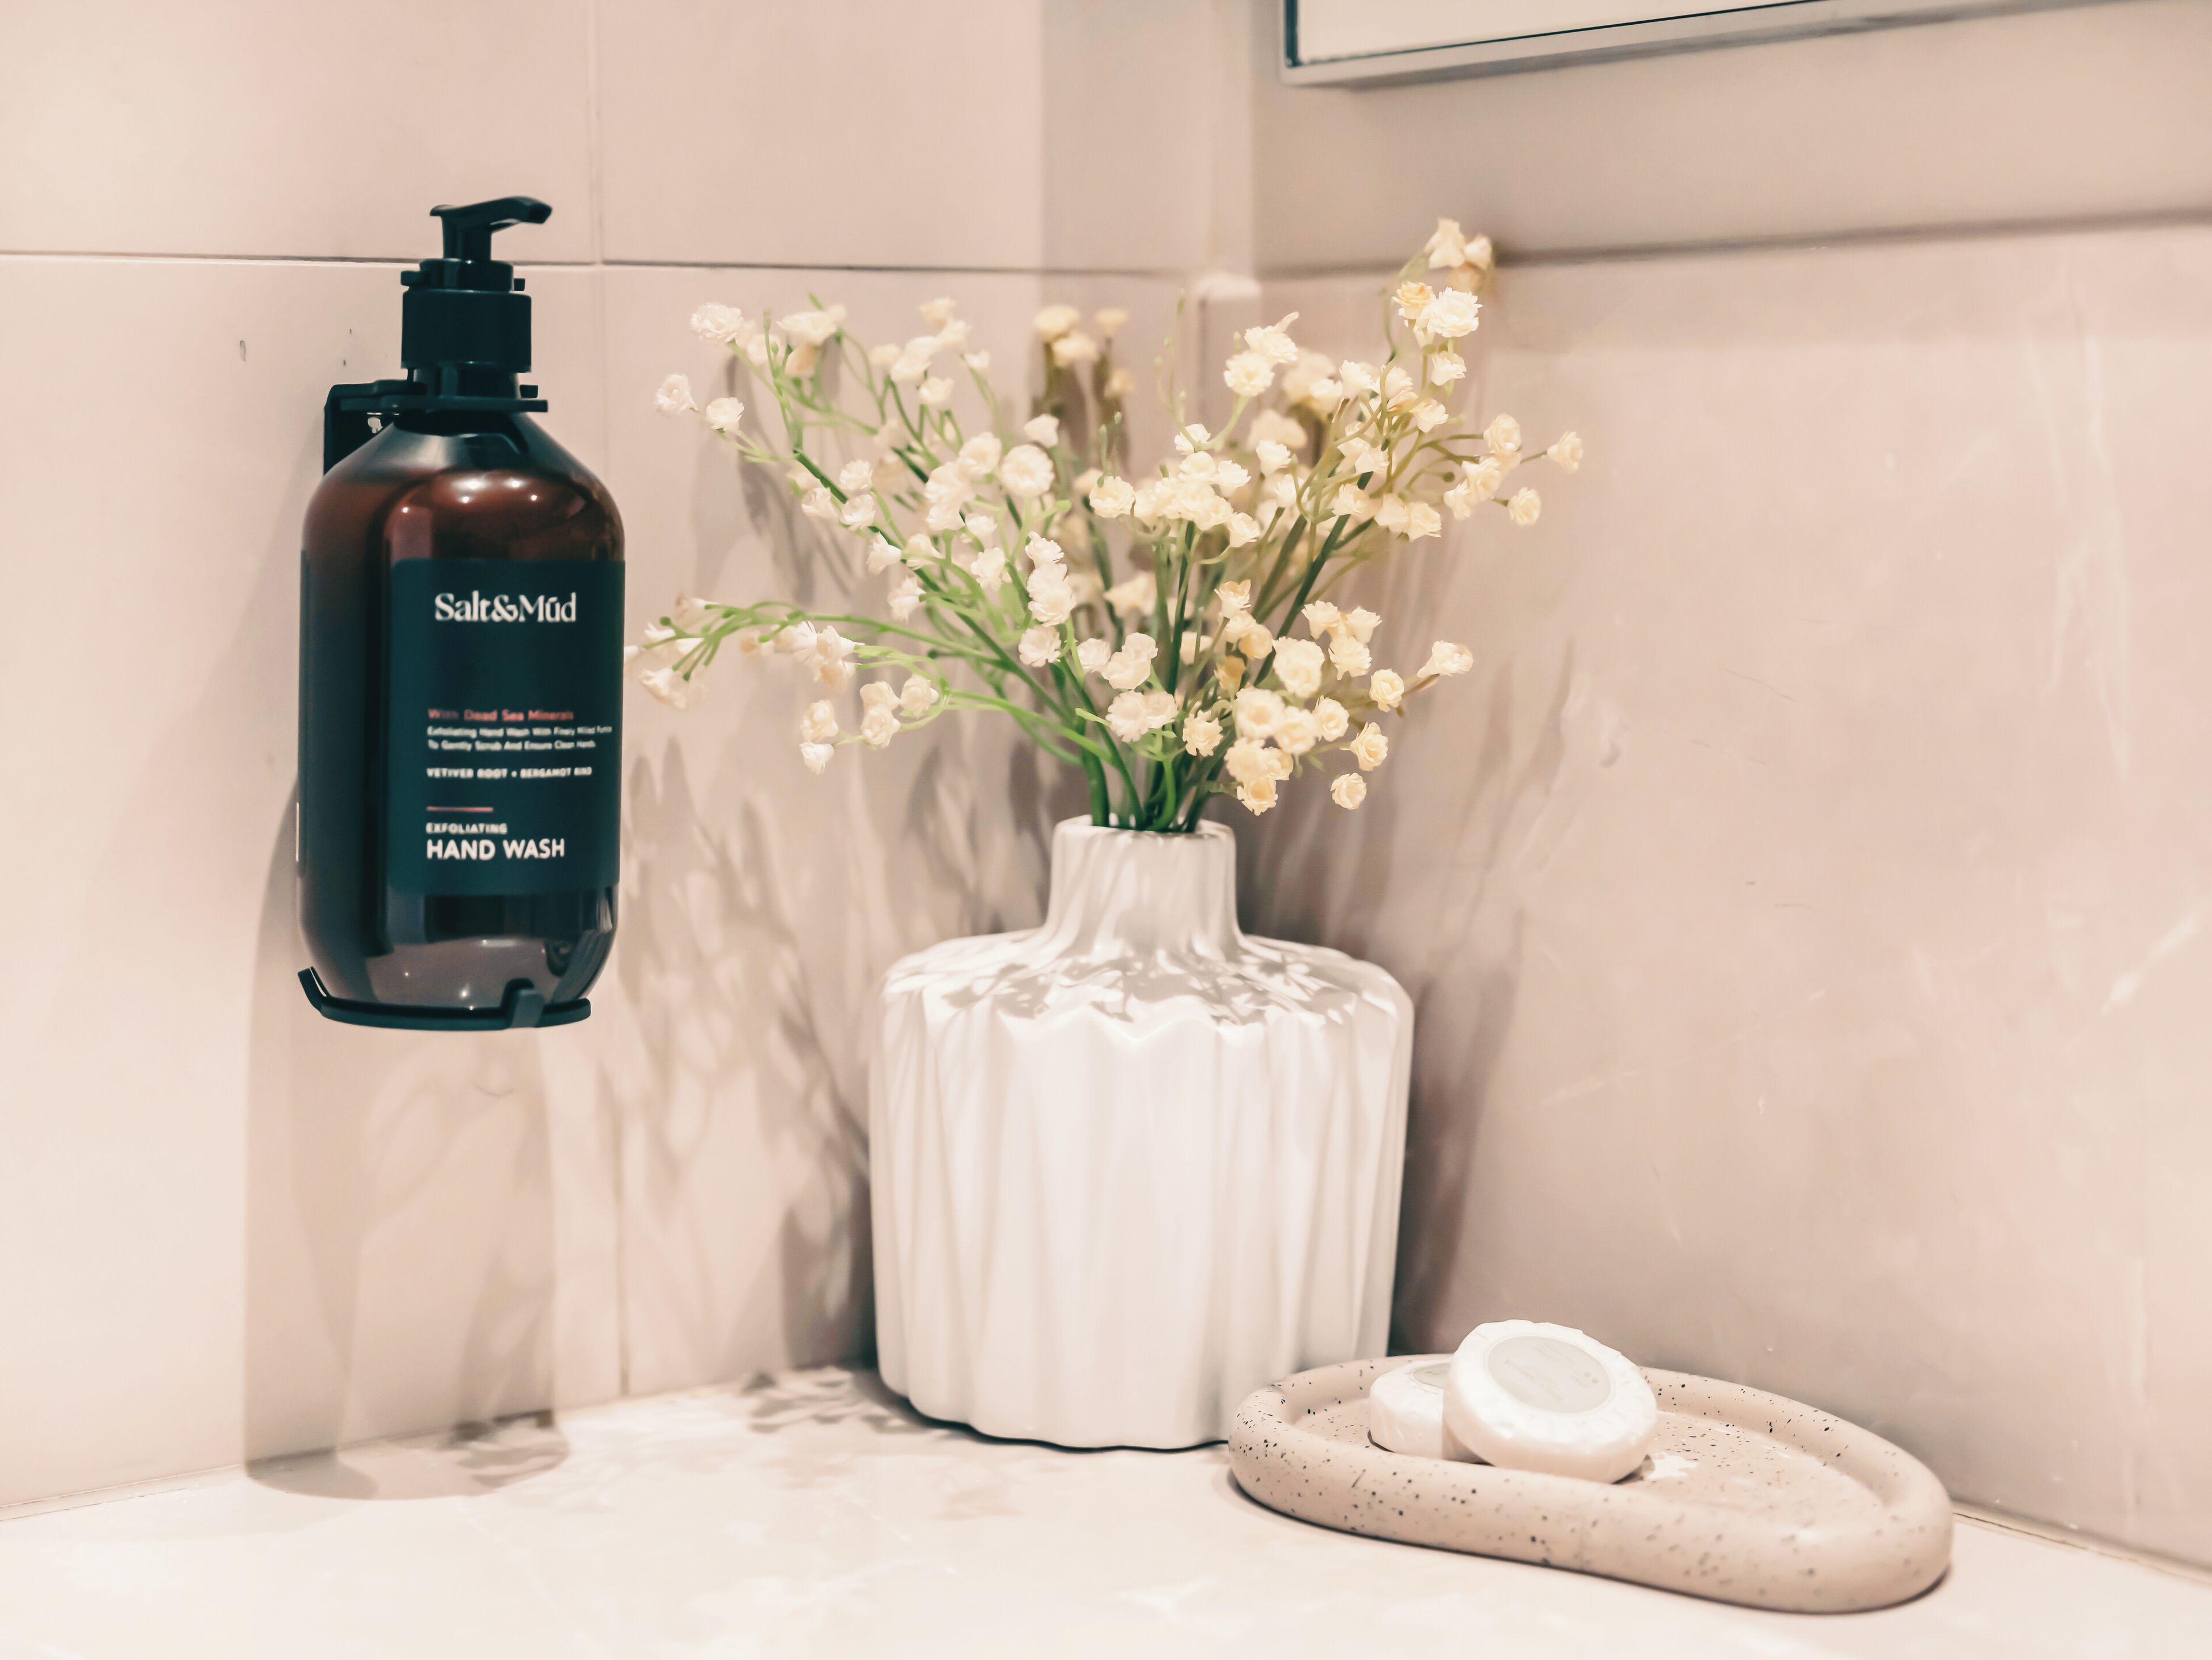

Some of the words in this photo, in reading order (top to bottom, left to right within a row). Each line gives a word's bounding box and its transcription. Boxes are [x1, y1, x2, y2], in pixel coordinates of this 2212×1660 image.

[464, 710, 498, 721] Dead
[502, 710, 524, 721] Sea
[426, 768, 474, 779] VETIVER
[477, 768, 508, 779] ROOT
[520, 767, 571, 779] BERGAMOT
[426, 822, 508, 835] EXFOLIATING
[427, 839, 495, 861] HAND
[502, 838, 565, 859] WASH
